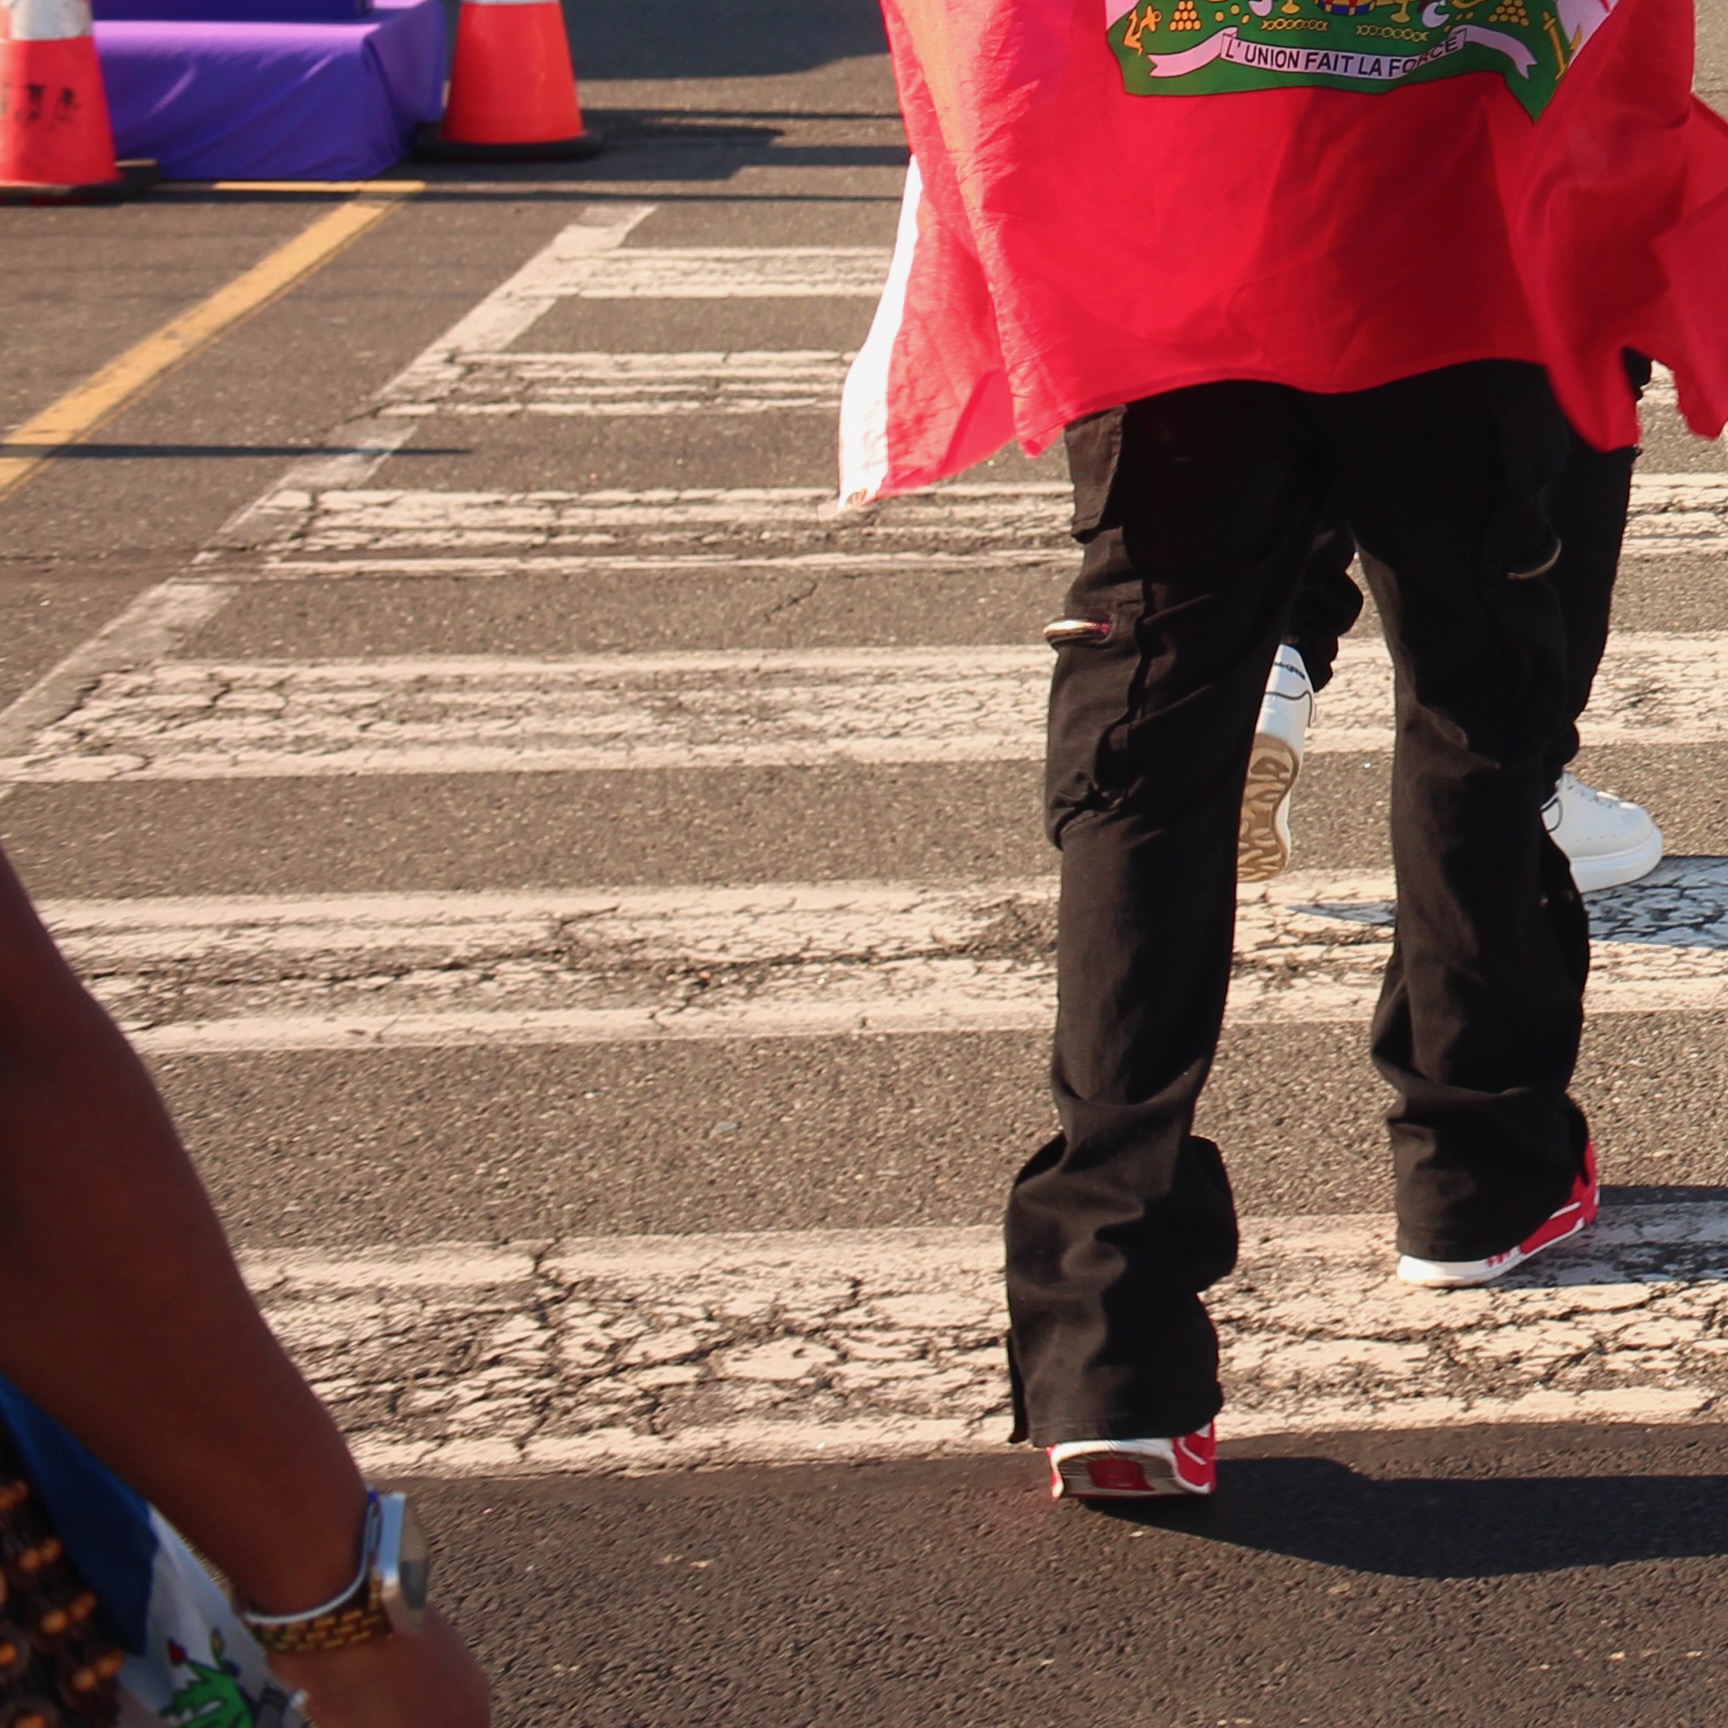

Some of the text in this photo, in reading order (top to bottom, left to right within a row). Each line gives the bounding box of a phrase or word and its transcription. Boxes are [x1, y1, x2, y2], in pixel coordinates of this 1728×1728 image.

[1304, 51, 1354, 74] FAIT
[1358, 56, 1383, 77] LA
[1388, 35, 1458, 78] FORCE
